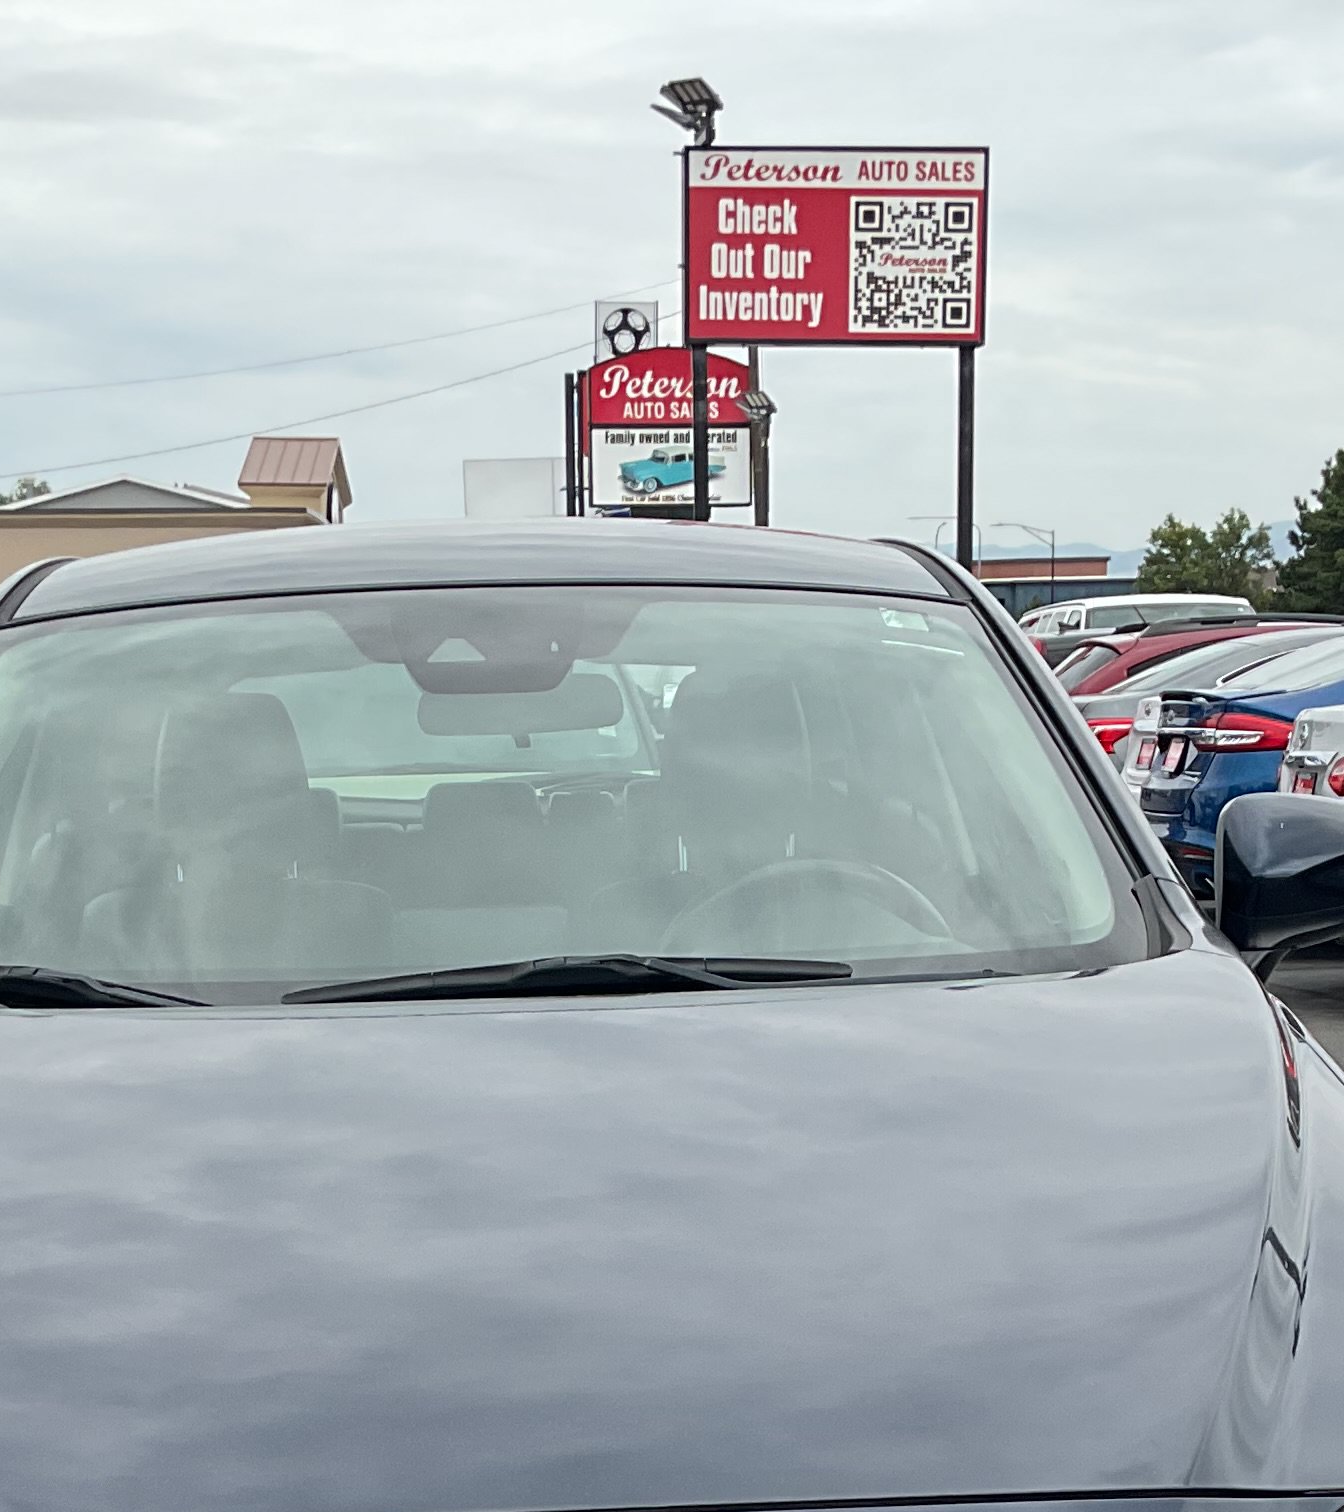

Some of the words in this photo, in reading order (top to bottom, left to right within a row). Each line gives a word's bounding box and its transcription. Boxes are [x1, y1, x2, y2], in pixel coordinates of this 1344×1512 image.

[700, 154, 843, 183] Peterson
[857, 160, 908, 182] AUTO
[915, 161, 976, 183] SALES
[718, 198, 798, 235] Check
[711, 242, 754, 279] Out
[763, 243, 812, 280] Our
[878, 252, 948, 268] Peterson
[699, 284, 824, 328] Inventory
[623, 402, 665, 419] AUTO
[670, 402, 719, 419] SAS
[605, 431, 635, 446] Family
[639, 431, 670, 443] owned
[673, 431, 690, 443] and
